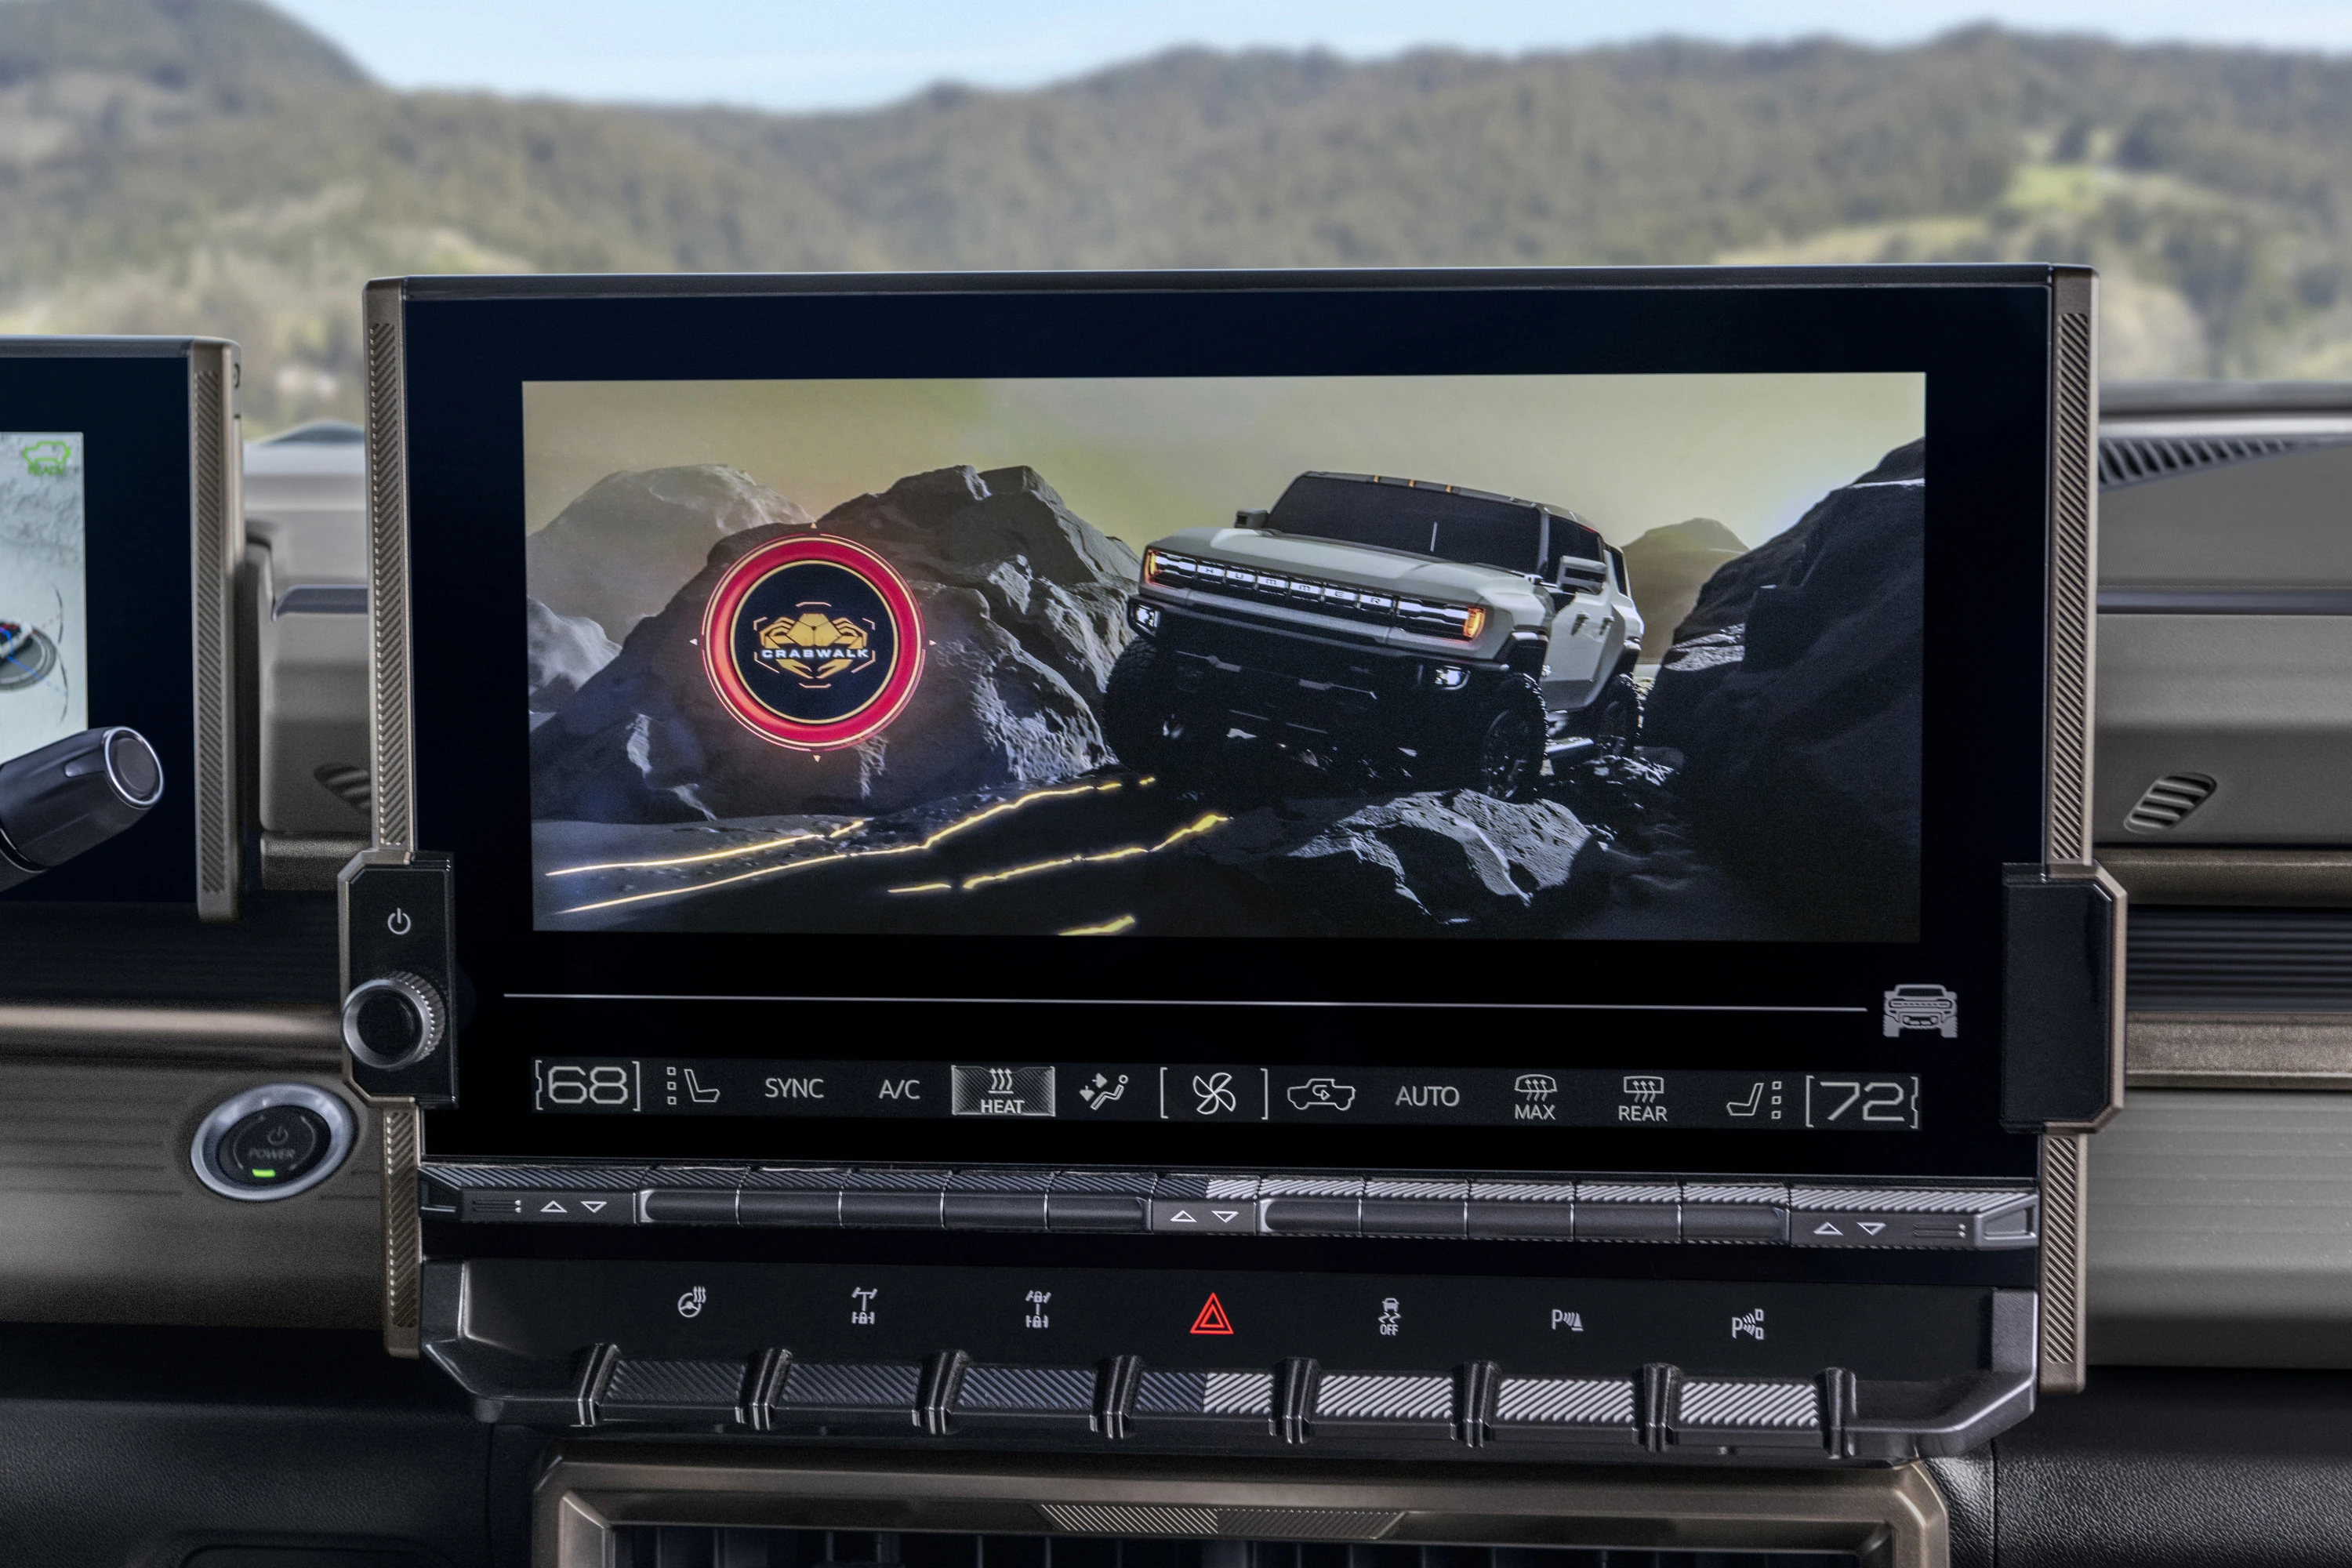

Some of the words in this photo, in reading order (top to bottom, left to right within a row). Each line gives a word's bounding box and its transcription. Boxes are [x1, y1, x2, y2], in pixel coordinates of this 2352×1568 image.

[760, 649, 869, 659] CRABWALK
[548, 1065, 627, 1104] 68
[764, 1077, 825, 1098] SYNC
[878, 1079, 920, 1100] A/C
[1395, 1085, 1460, 1107] AUTO
[1820, 1082, 1904, 1121] 72
[980, 1099, 1025, 1114] HEAT
[1515, 1104, 1556, 1120] MAX
[1618, 1105, 1668, 1122] REAR
[246, 1147, 296, 1160] POWER
[1380, 1323, 1399, 1336] OFF
